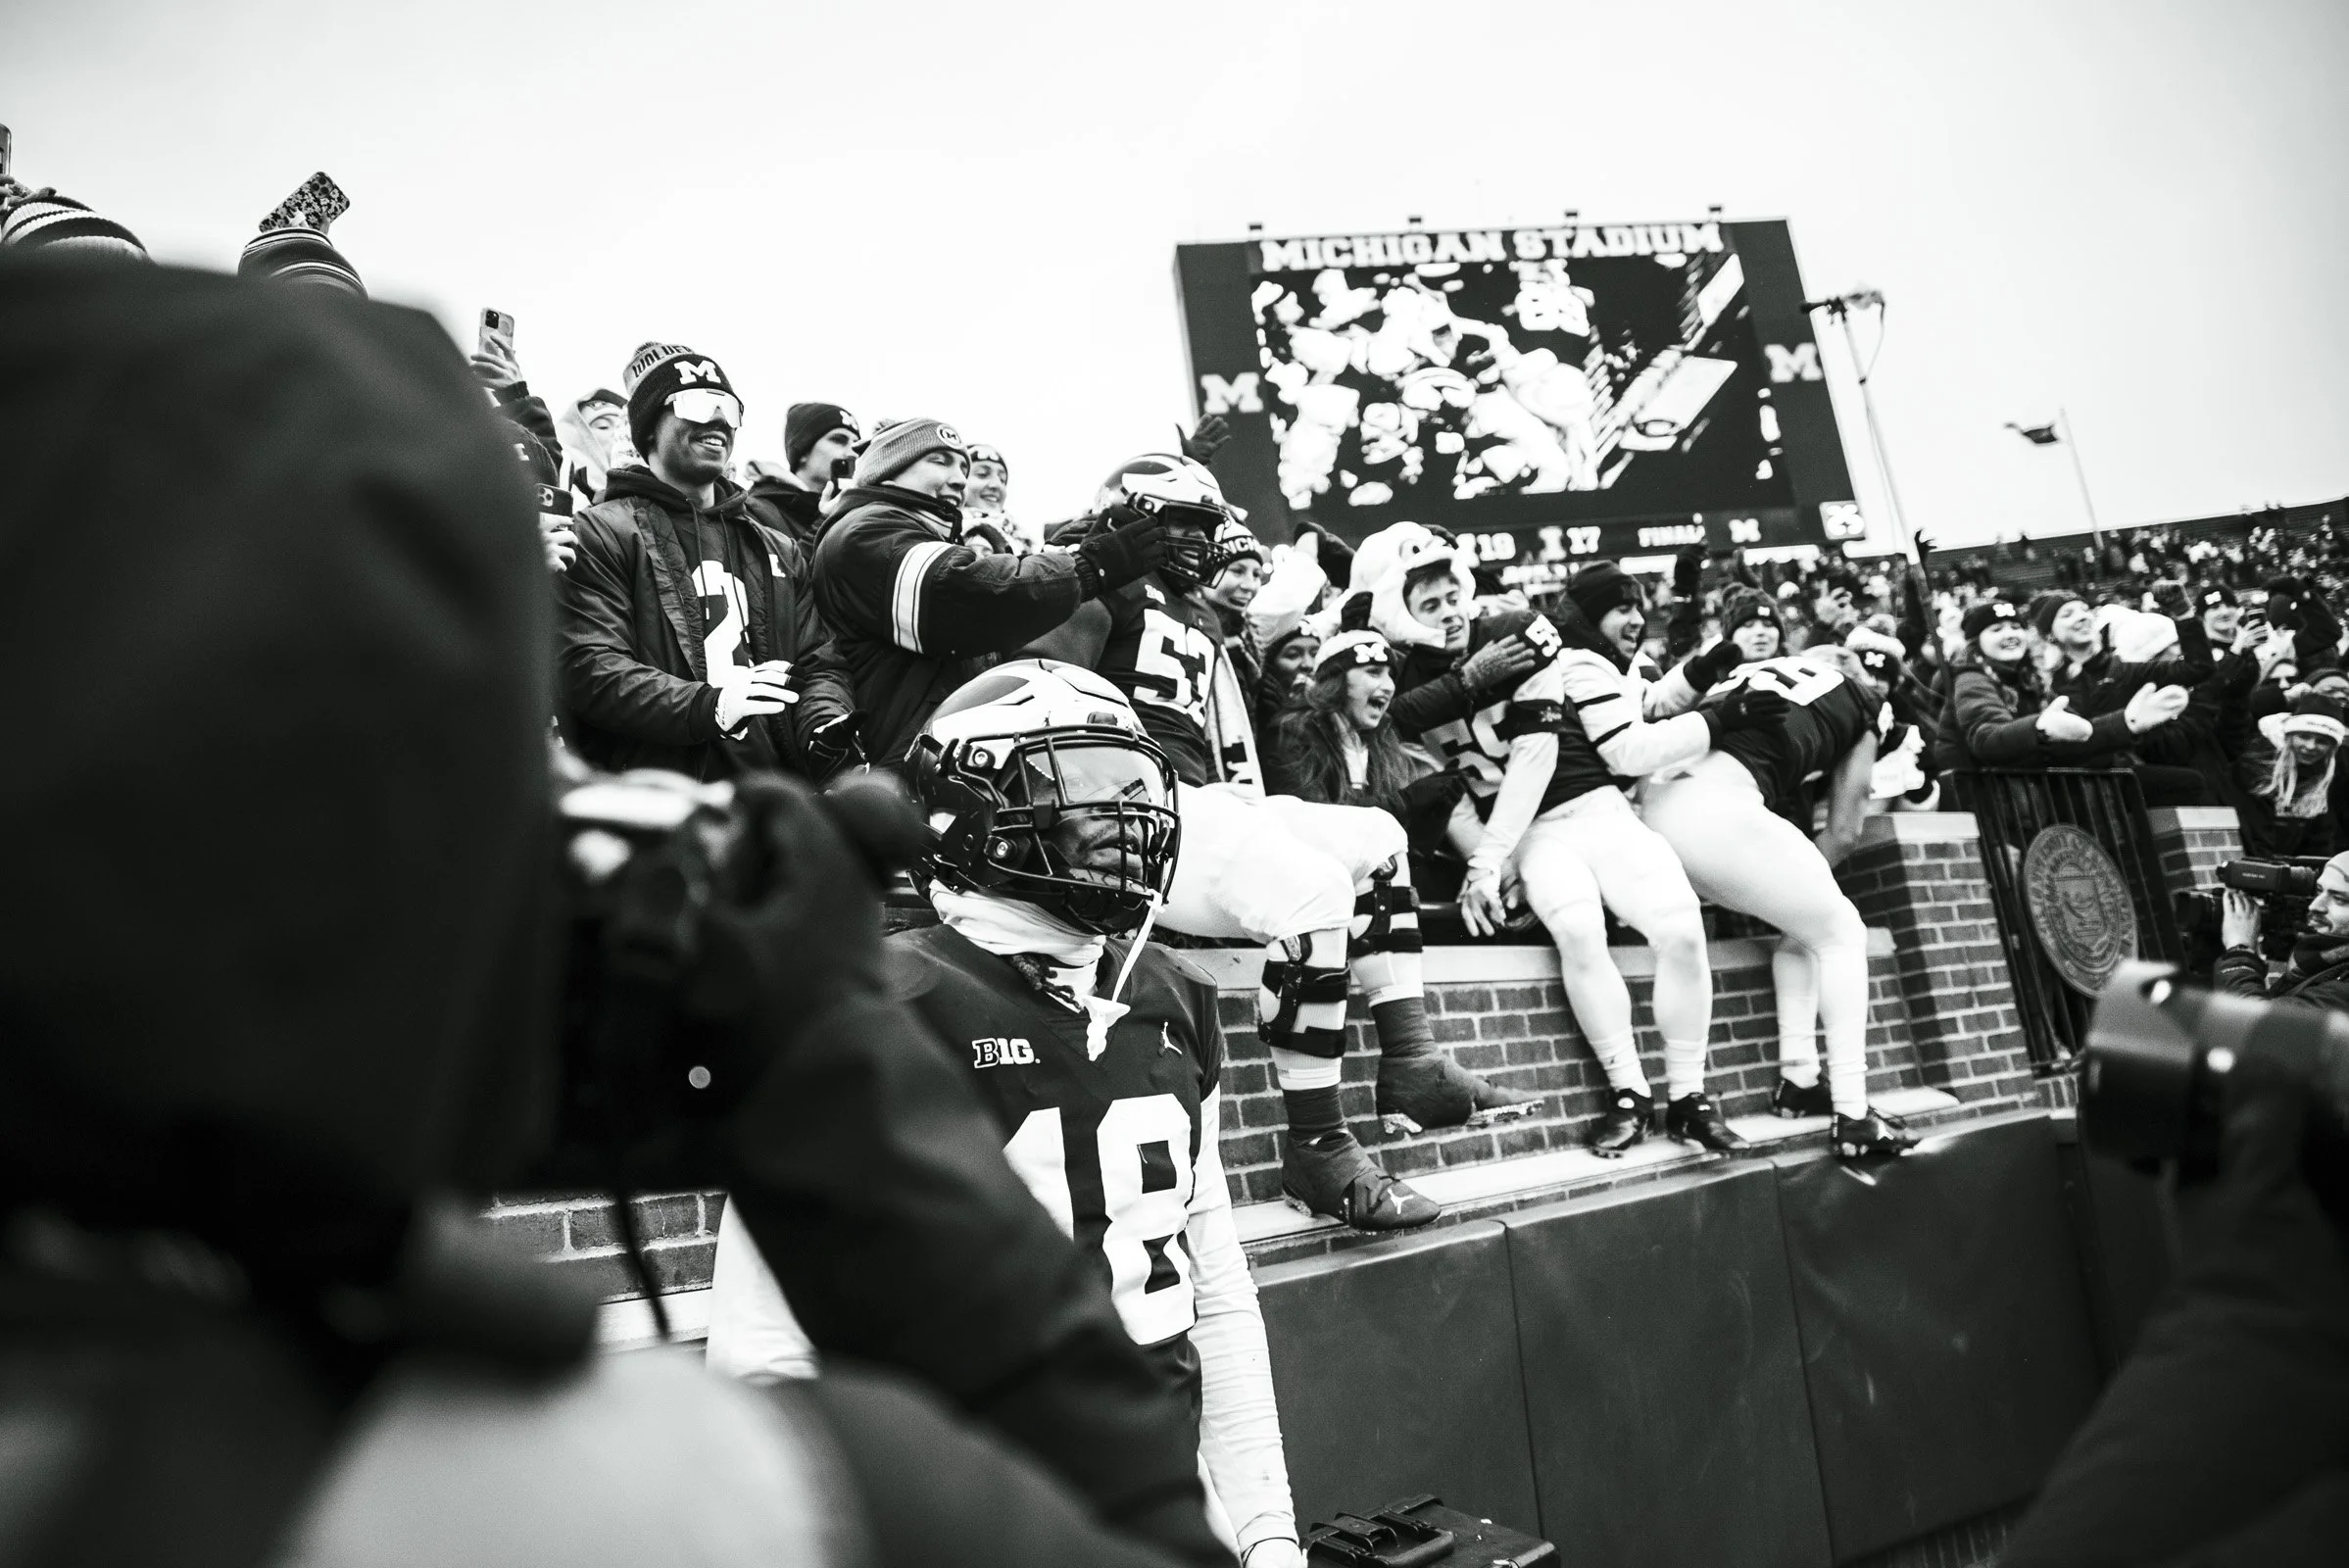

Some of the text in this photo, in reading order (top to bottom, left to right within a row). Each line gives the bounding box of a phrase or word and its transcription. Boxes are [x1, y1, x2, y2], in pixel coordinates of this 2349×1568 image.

[1260, 222, 1725, 271] MICHIGAN STADIUM
[674, 360, 721, 385] M
[1764, 342, 1823, 382] M
[1200, 371, 1263, 415] M
[691, 560, 755, 689] 2
[1353, 643, 1388, 663] M
[1003, 1093, 1196, 1345] 18
